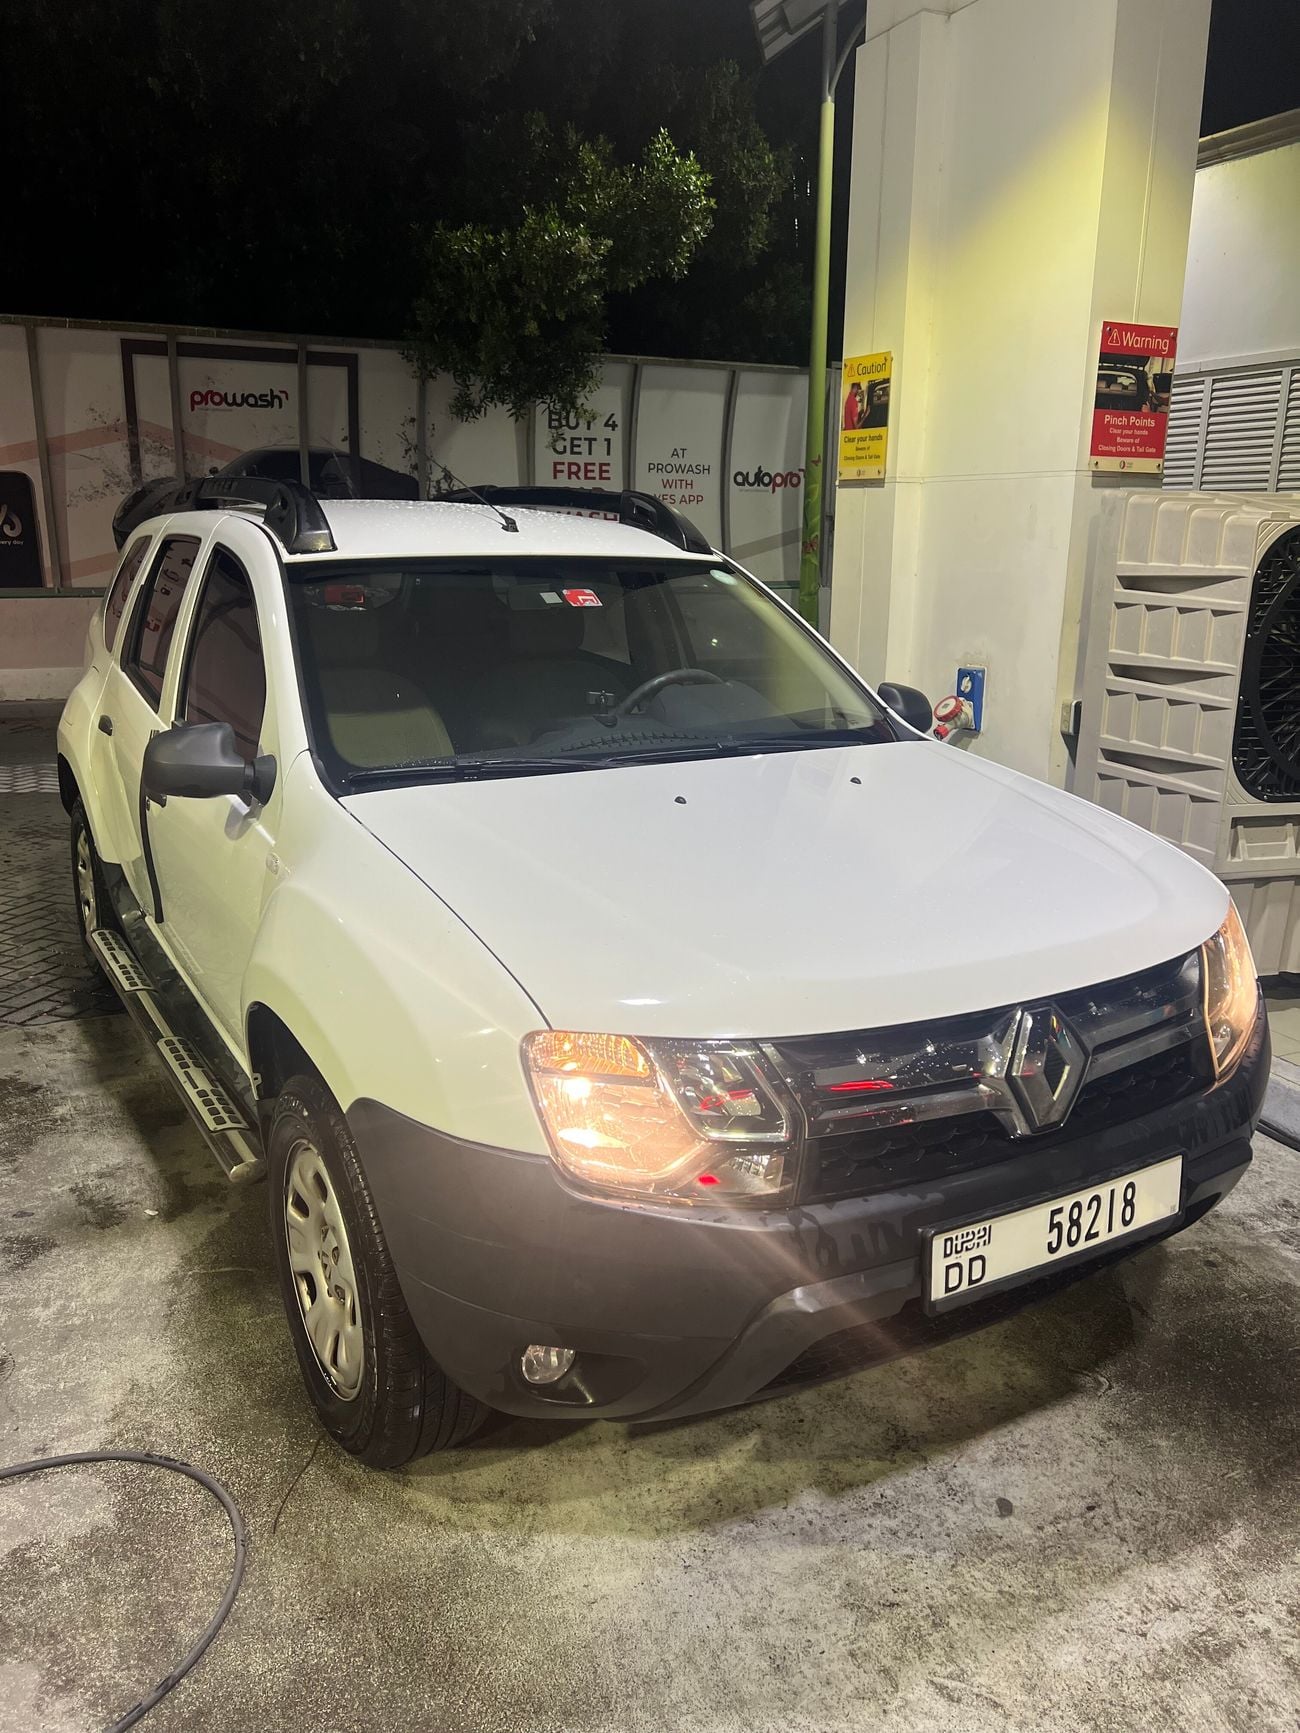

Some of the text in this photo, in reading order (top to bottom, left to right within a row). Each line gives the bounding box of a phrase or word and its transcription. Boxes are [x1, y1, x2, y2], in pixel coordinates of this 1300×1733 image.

[1122, 331, 1170, 355] Warning
[856, 361, 887, 376] Caution
[190, 388, 285, 412] prowash
[603, 412, 619, 431] 4
[1104, 414, 1156, 427] Pinch Points
[552, 436, 611, 456] GET 1
[670, 448, 688, 459] AT
[1098, 444, 1116, 452] Closing
[552, 461, 611, 480] FREE
[648, 462, 711, 475] PROWASH
[661, 478, 694, 490] WITH
[733, 465, 802, 494] autopro
[679, 494, 704, 505] APP
[1047, 1181, 1137, 1254] 58218
[944, 1254, 987, 1294] DD
